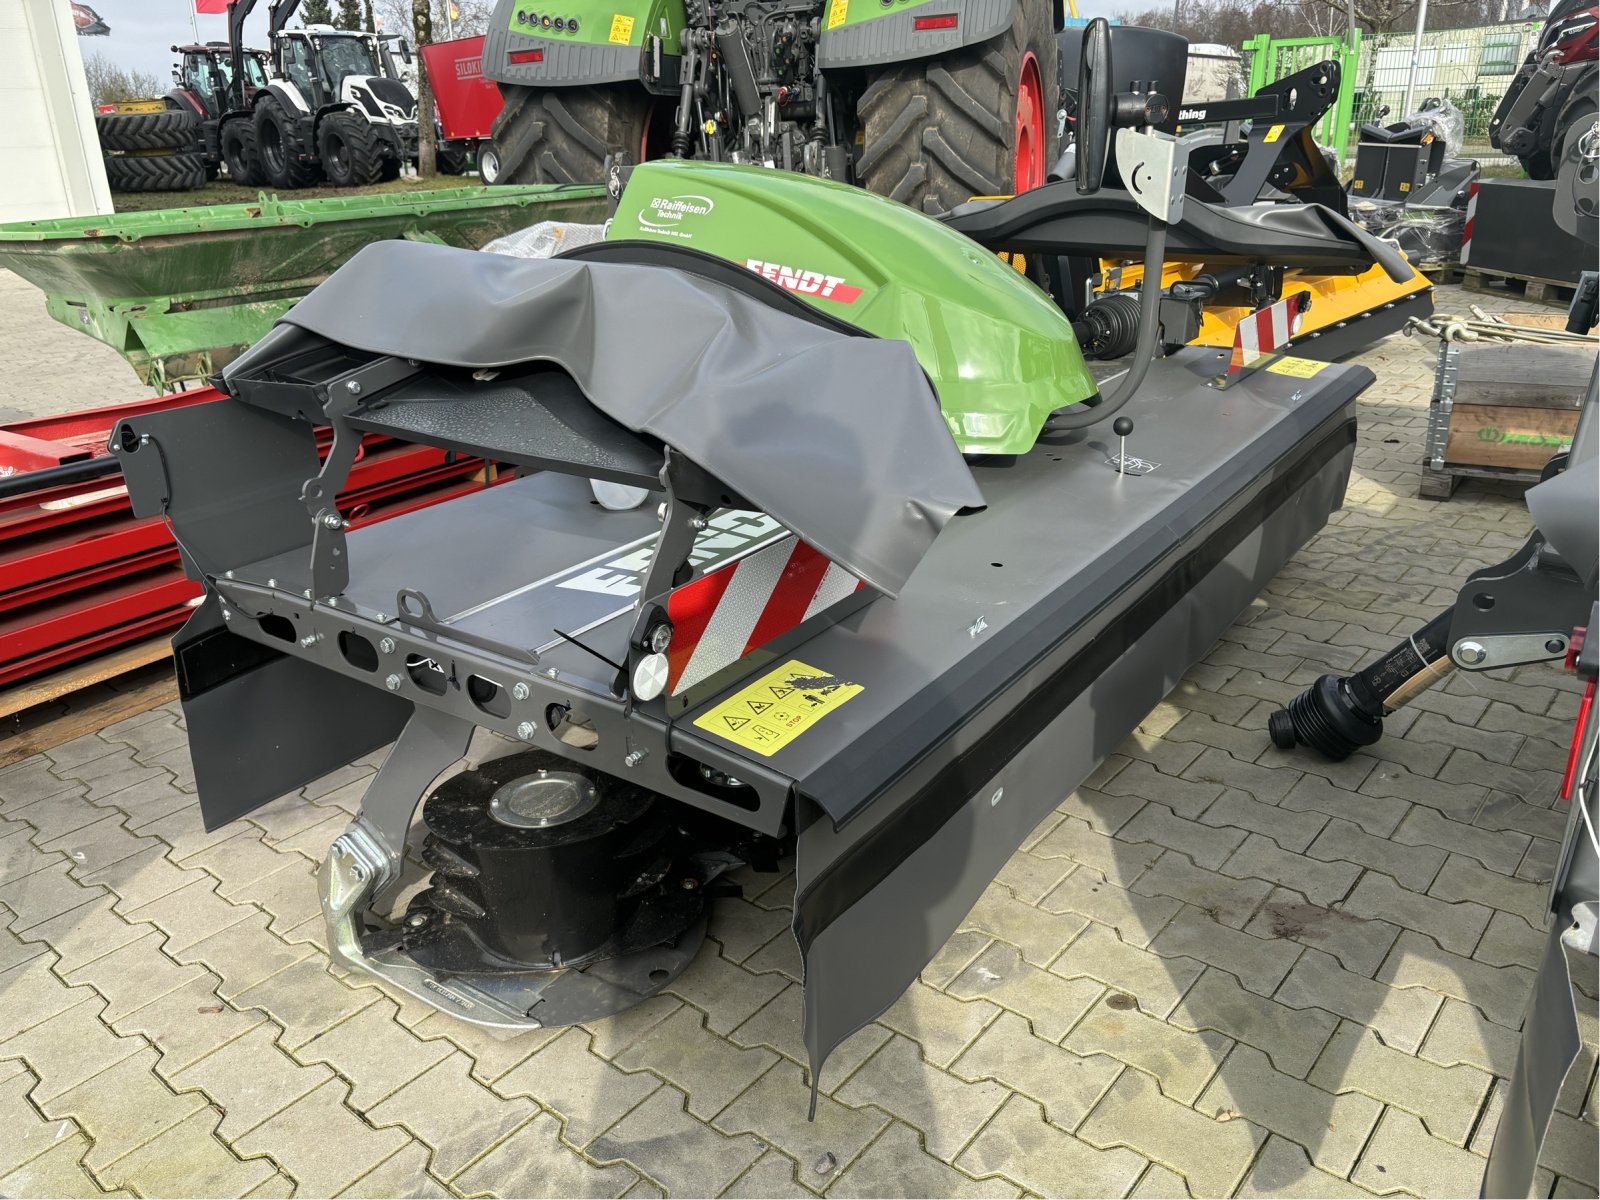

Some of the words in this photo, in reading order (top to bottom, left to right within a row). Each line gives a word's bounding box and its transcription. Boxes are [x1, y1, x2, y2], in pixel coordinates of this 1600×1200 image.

[455, 60, 482, 76] SILOKI
[657, 209, 683, 220] Technik
[660, 199, 706, 215] Raiffeisen
[746, 258, 846, 297] FENDT
[786, 714, 803, 728] STOP
